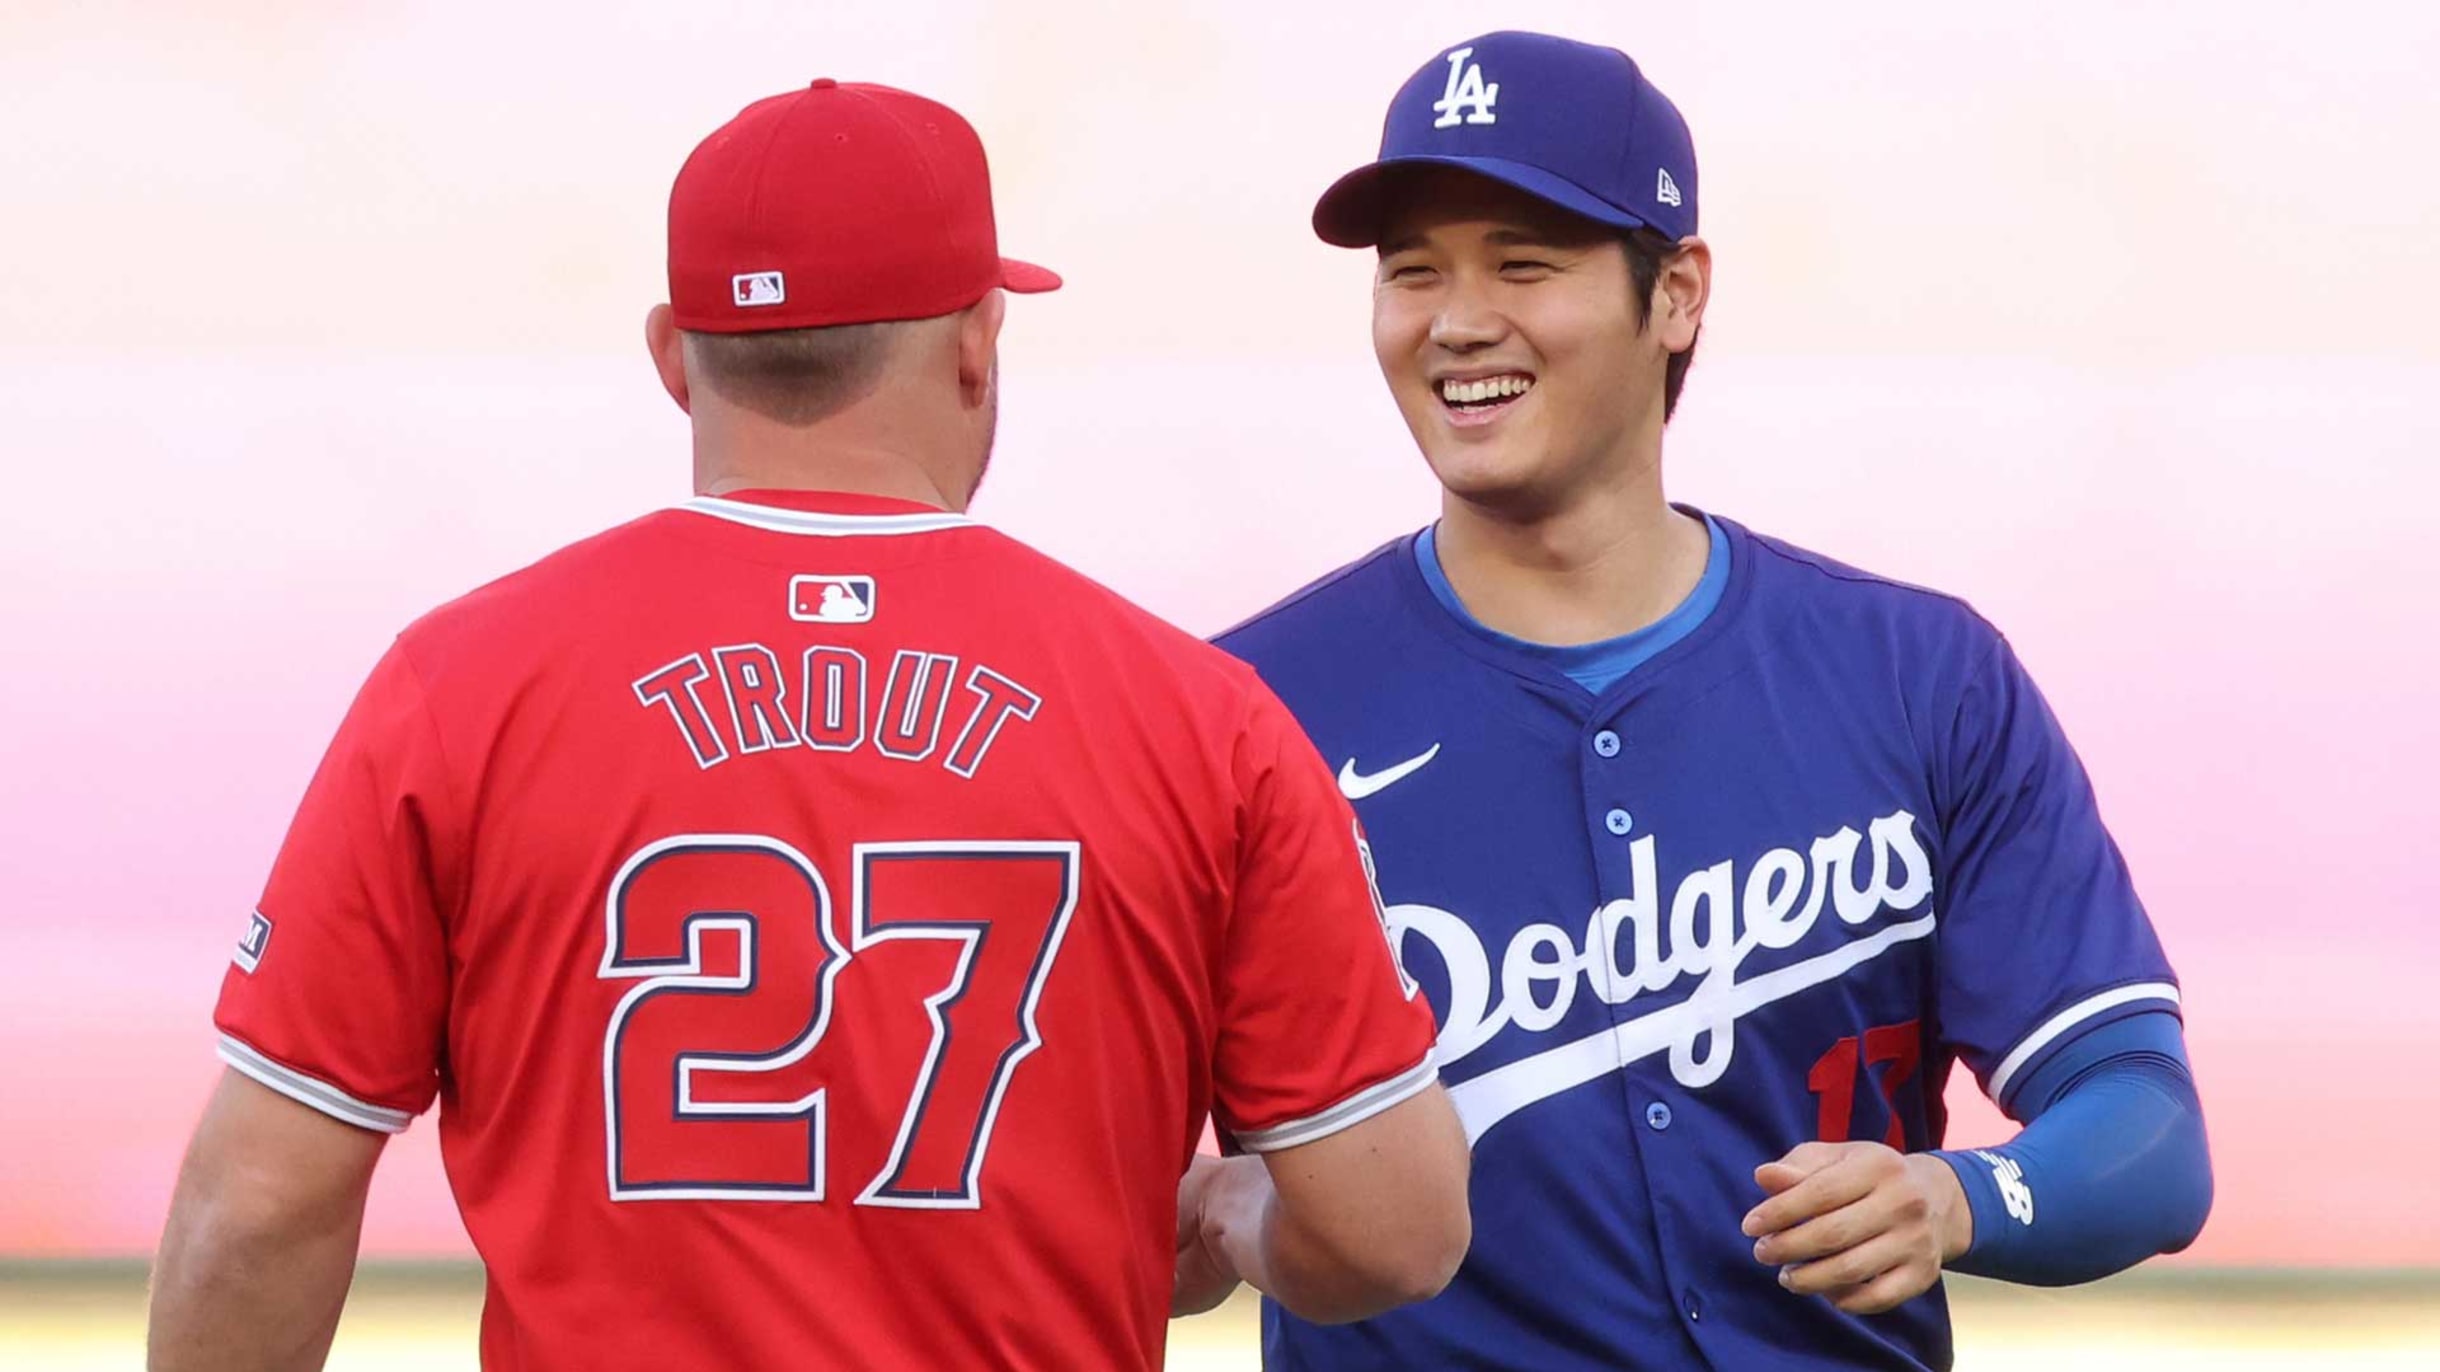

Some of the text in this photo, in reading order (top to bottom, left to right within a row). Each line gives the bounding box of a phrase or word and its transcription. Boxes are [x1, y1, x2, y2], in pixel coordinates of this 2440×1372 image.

[1433, 47, 1499, 129] LA
[632, 643, 1042, 778] TROUT
[1386, 809, 1934, 1088] Dodgers
[597, 834, 1081, 1209] 27
[1807, 1019, 1922, 1151] 17
